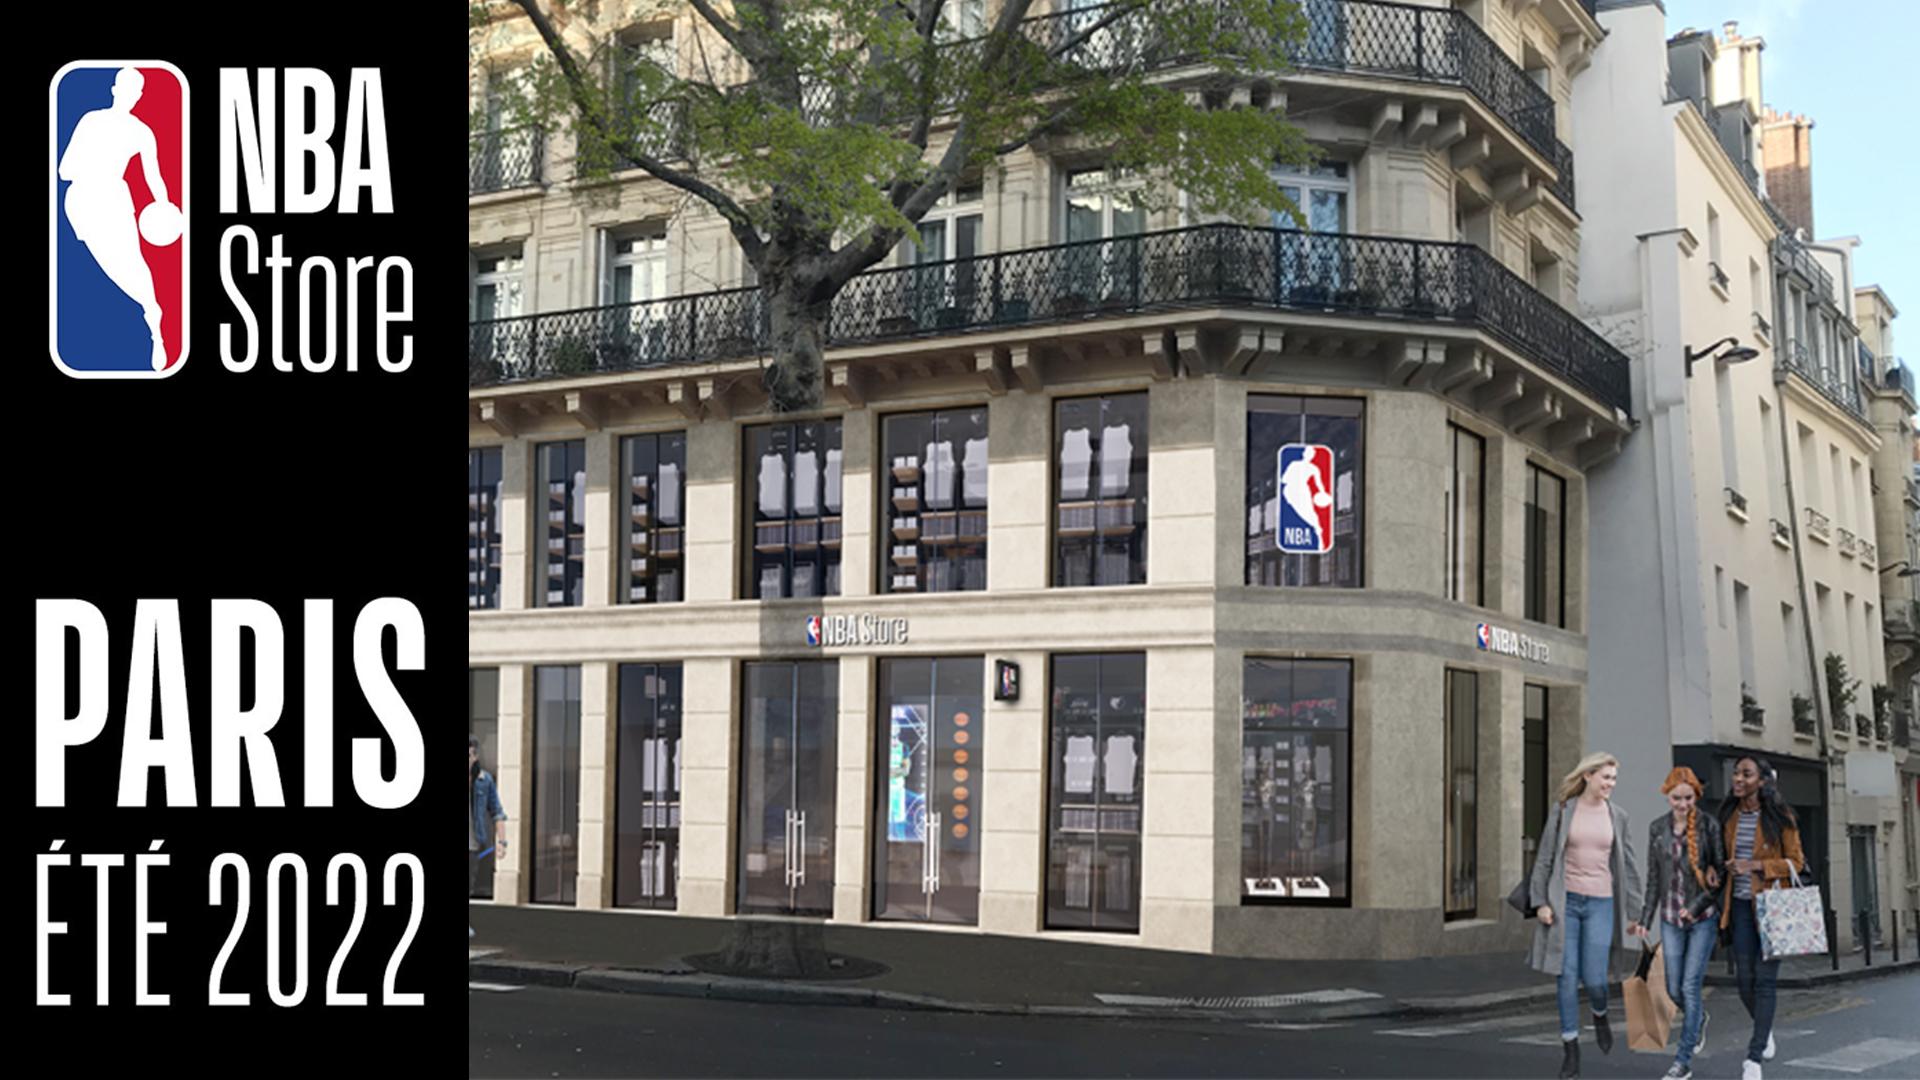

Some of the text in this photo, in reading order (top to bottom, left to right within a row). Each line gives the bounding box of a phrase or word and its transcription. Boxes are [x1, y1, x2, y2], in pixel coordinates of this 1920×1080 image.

[1284, 527, 1312, 545] NBA
[822, 613, 908, 646] NBA Store
[1491, 626, 1550, 663] NBA Store
